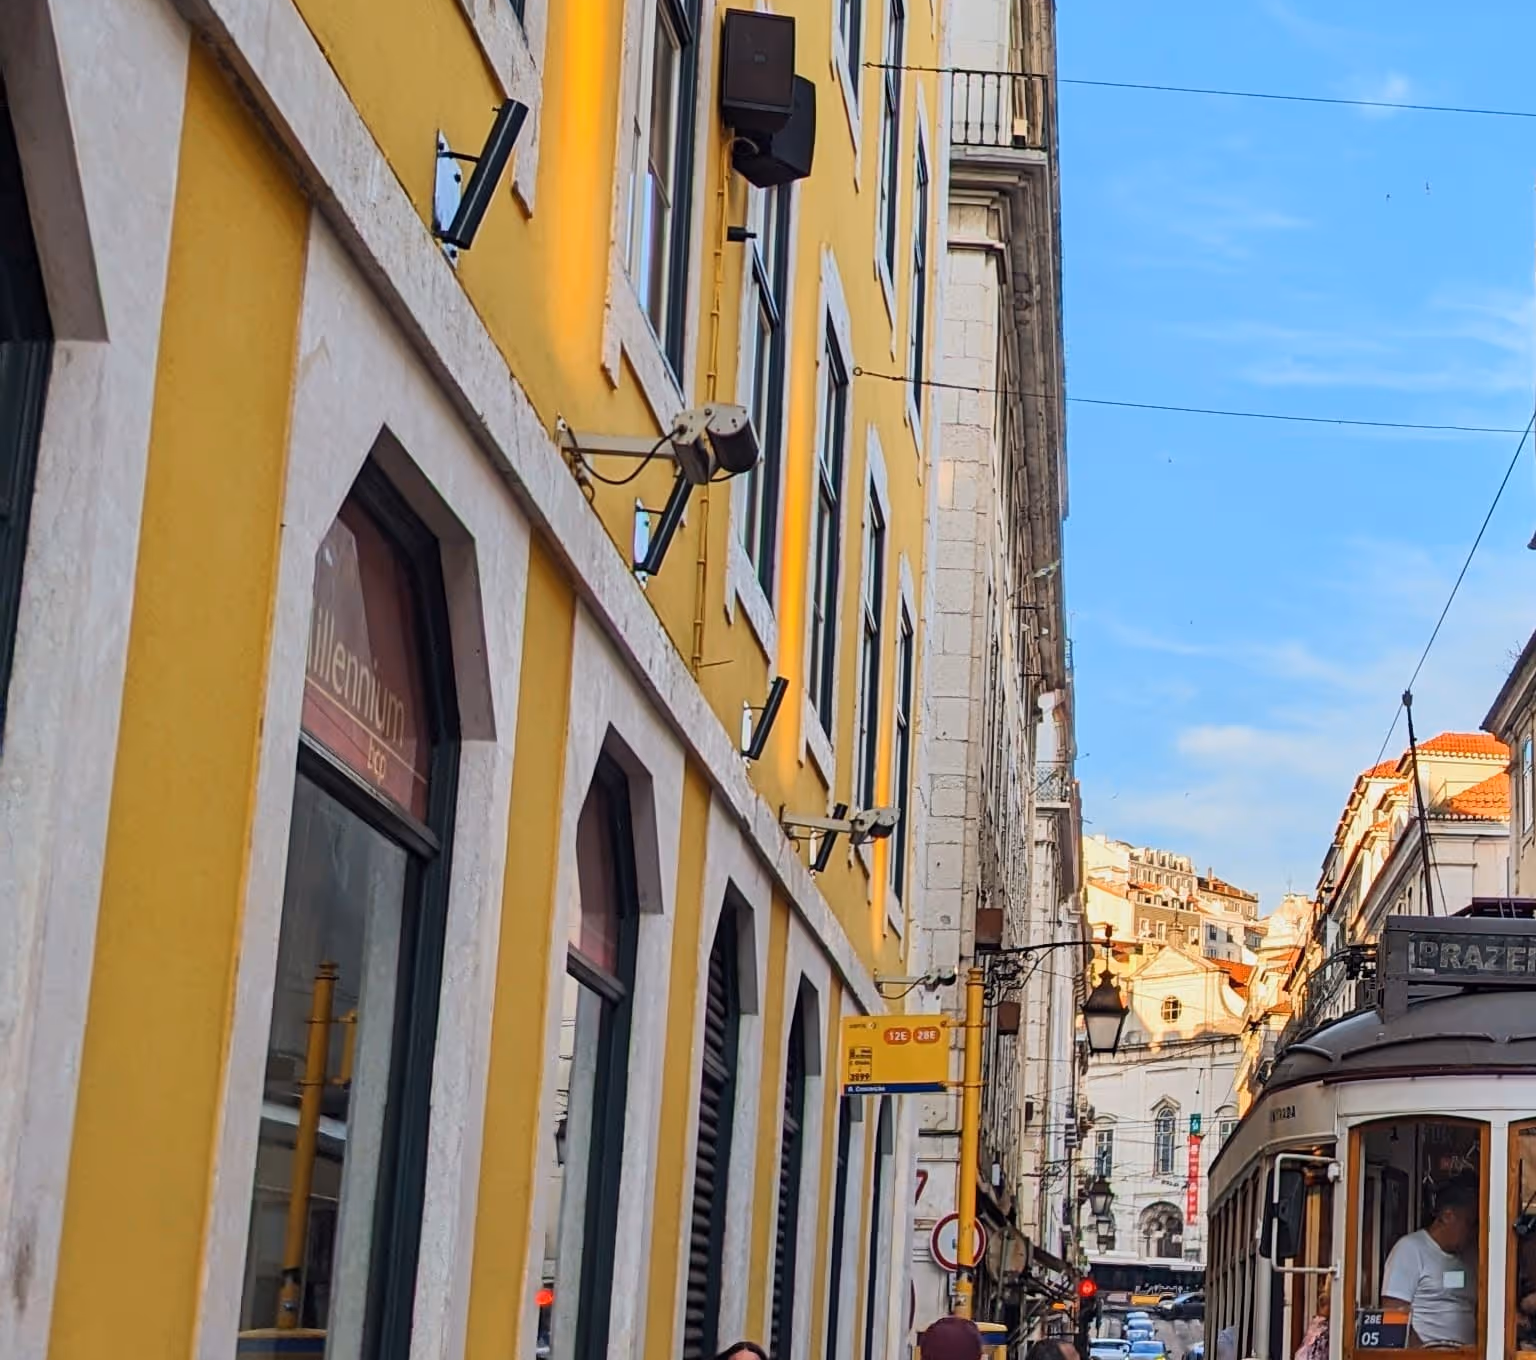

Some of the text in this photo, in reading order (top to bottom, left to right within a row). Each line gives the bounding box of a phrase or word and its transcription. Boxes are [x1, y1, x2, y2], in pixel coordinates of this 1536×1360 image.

[307, 607, 406, 748] illennium
[367, 736, 387, 787] bcp
[888, 1029, 937, 1041] 12E 28E
[1364, 1314, 1382, 1325] 28E
[1361, 1331, 1379, 1346] 05
